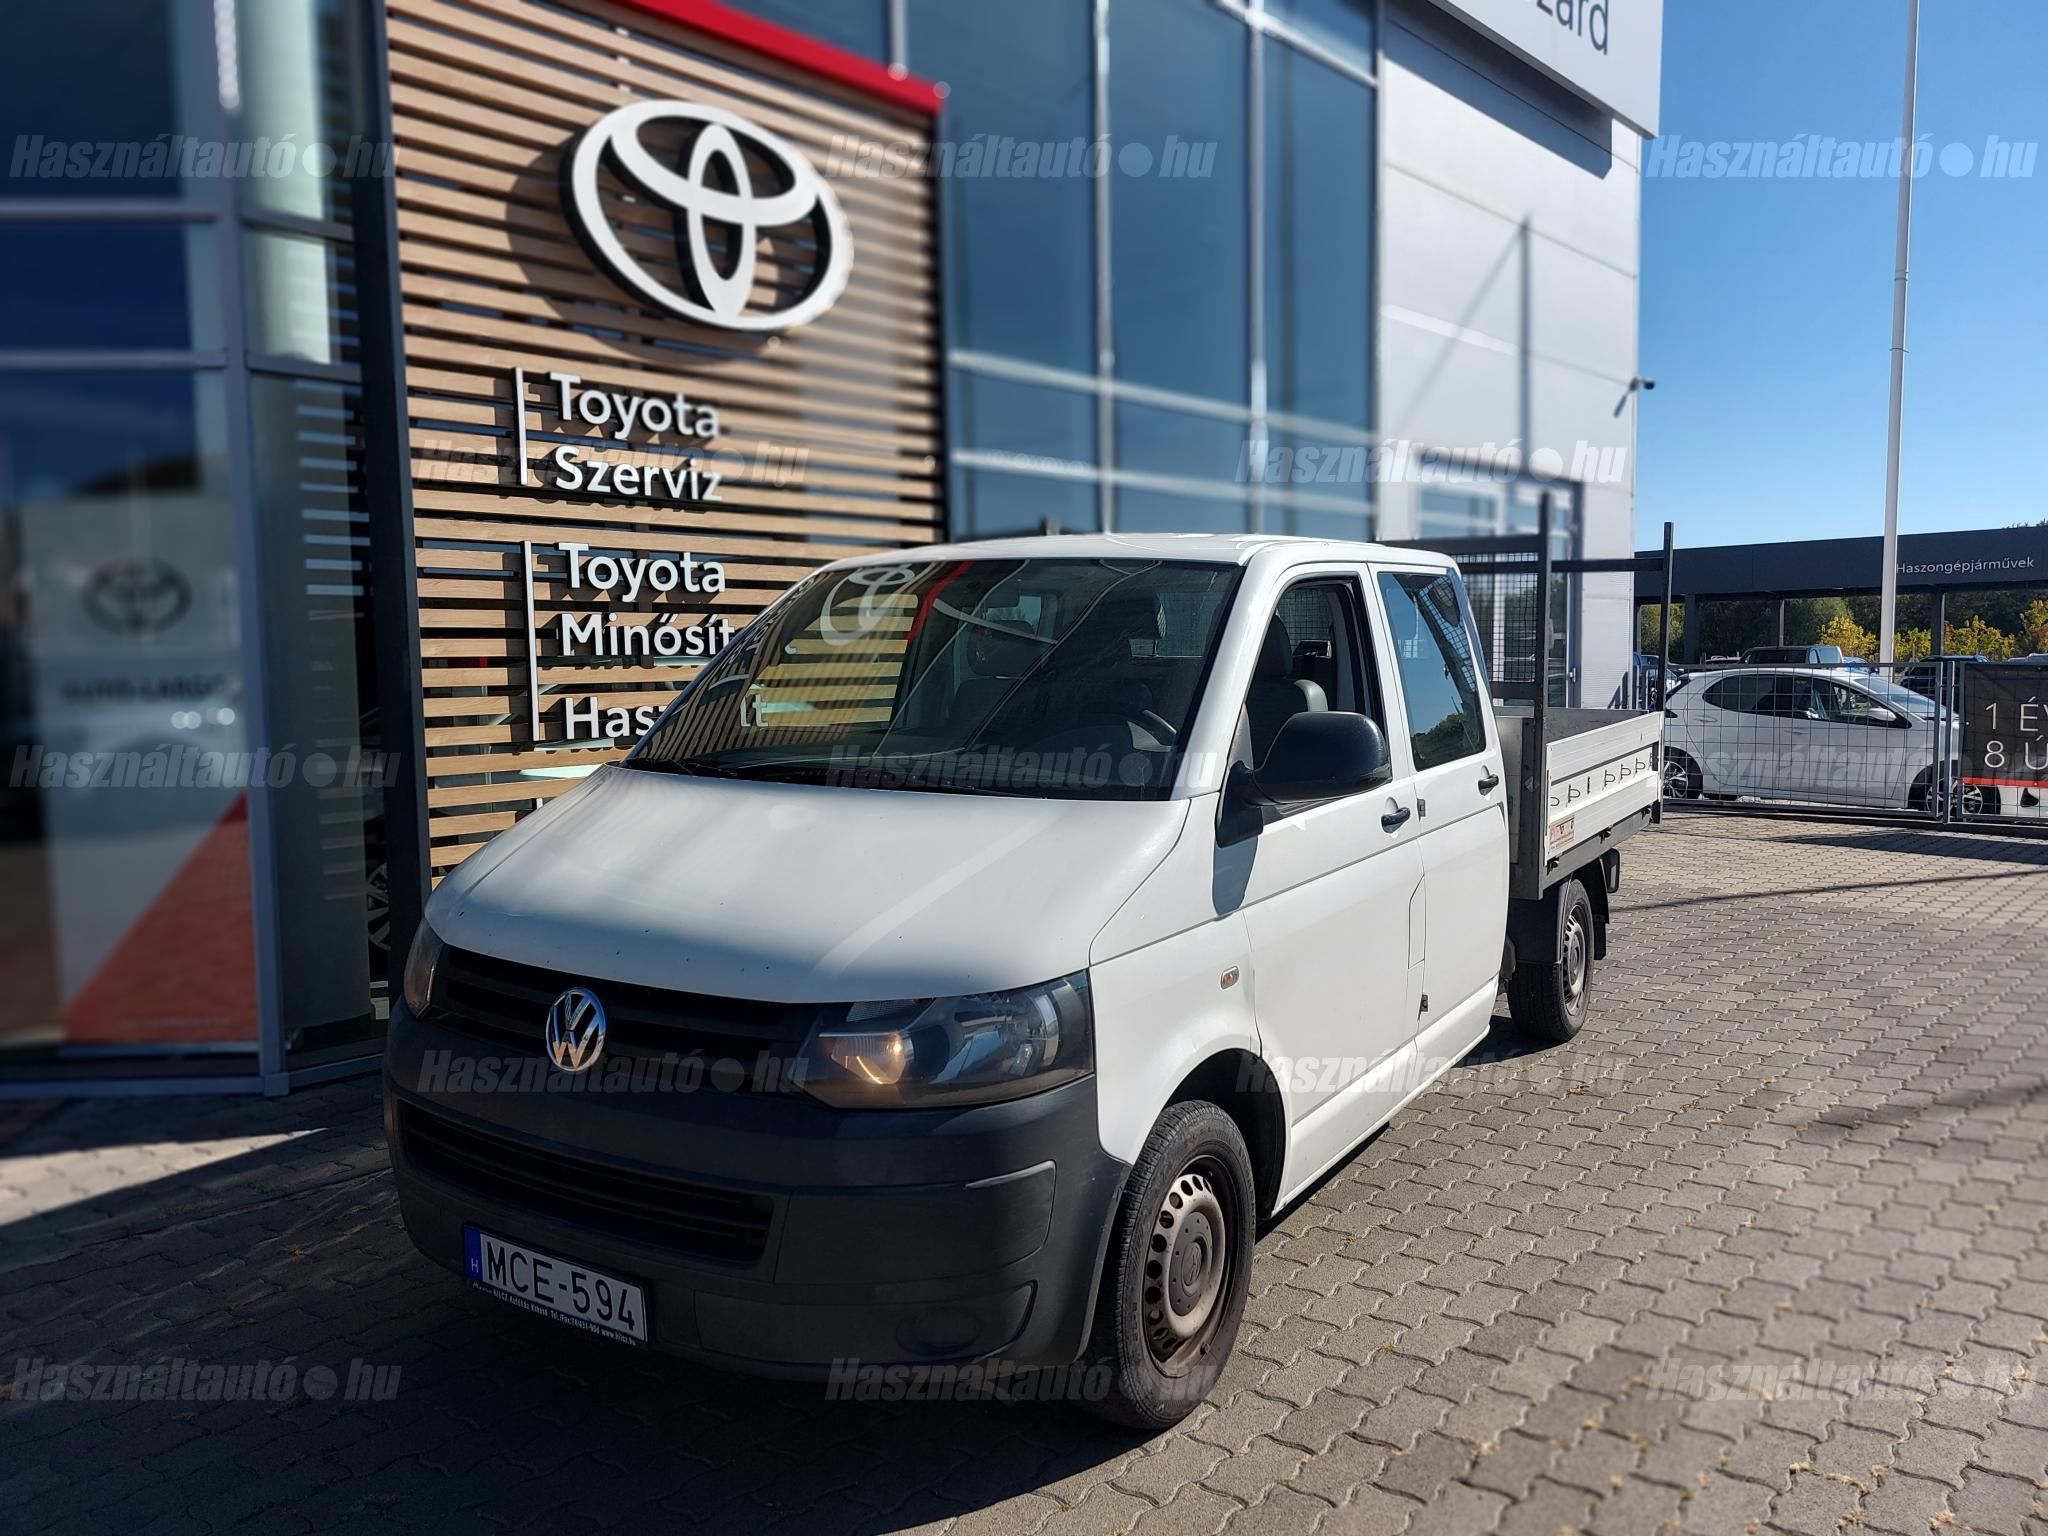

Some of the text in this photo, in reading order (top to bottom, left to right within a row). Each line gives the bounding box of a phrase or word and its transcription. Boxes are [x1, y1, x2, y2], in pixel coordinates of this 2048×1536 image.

[550, 371, 722, 438] Toyota
[555, 446, 723, 502] Szerviz
[558, 542, 726, 602] Toyota
[1896, 556, 2035, 575] Haszongépjárművek
[562, 612, 735, 656] Minősít
[1985, 696, 2048, 732] 1 É
[1984, 740, 2005, 768] 8
[471, 1257, 479, 1273] H
[487, 1242, 635, 1330] MCE-594
